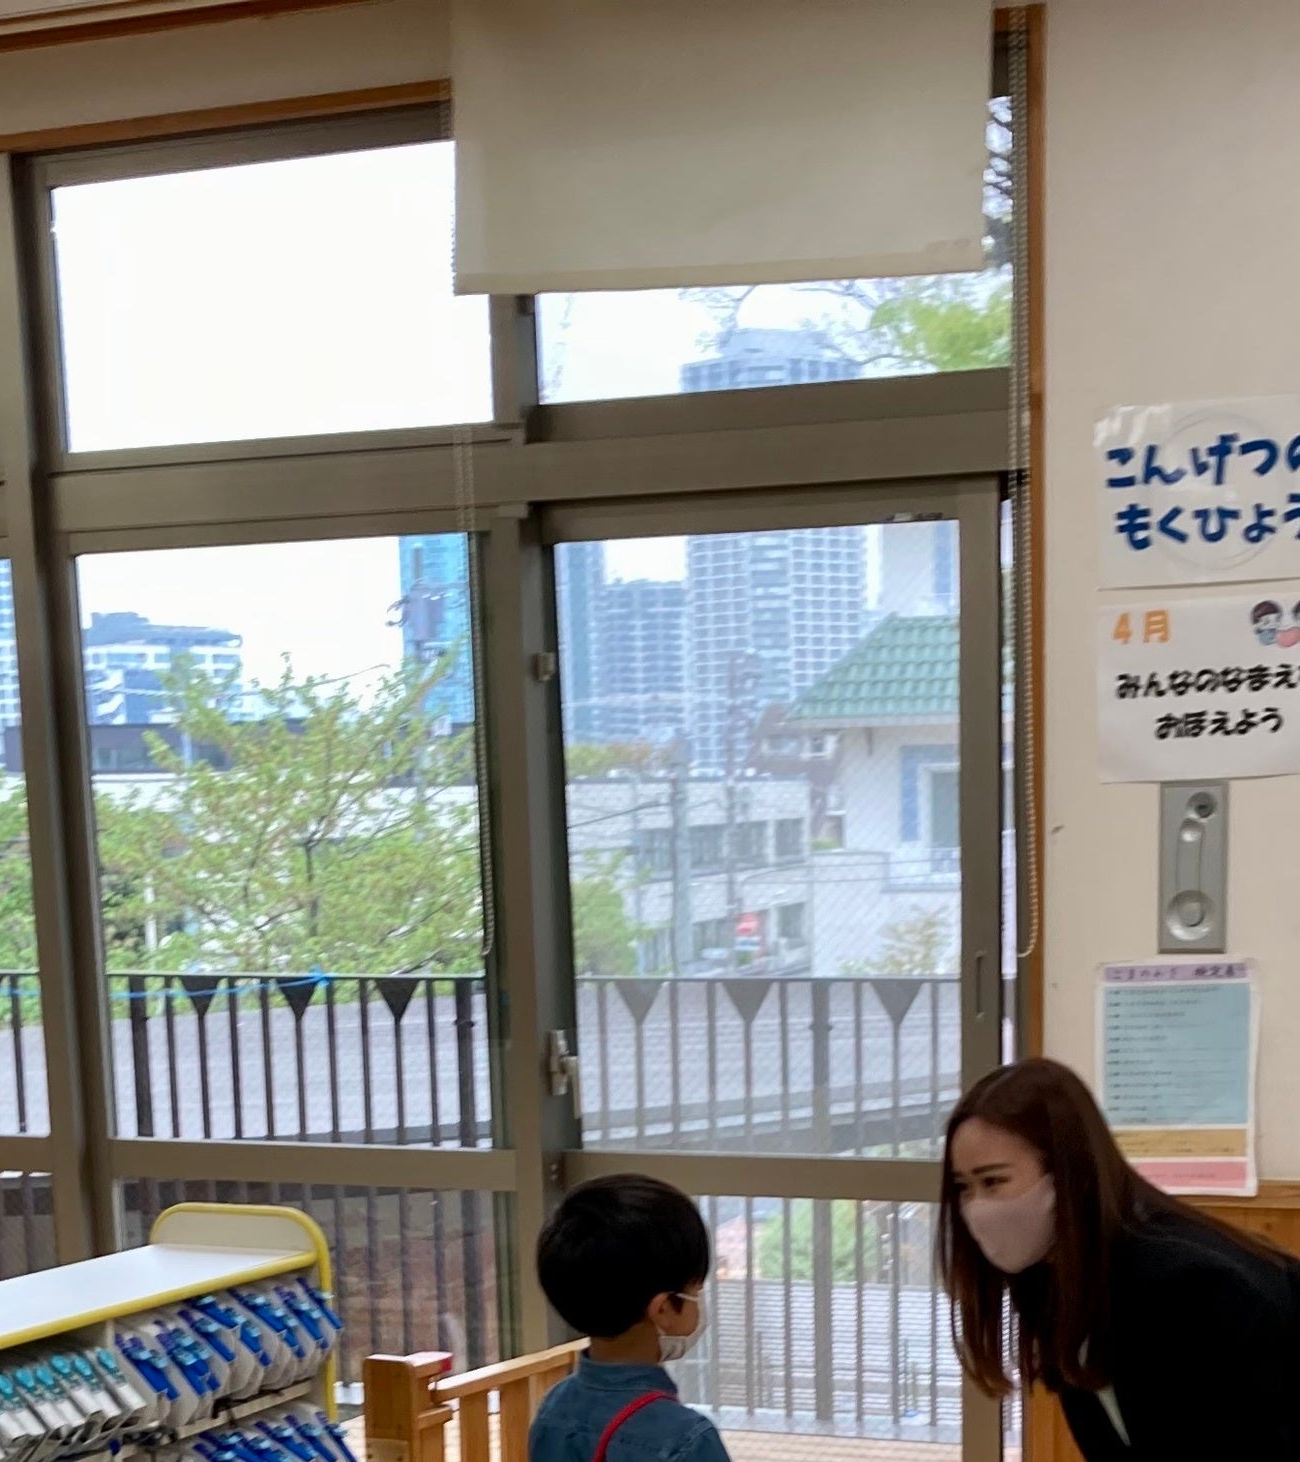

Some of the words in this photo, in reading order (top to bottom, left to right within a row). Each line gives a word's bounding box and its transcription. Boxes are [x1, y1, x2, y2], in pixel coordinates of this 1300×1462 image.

[1155, 706, 1283, 740] おぼえよう
